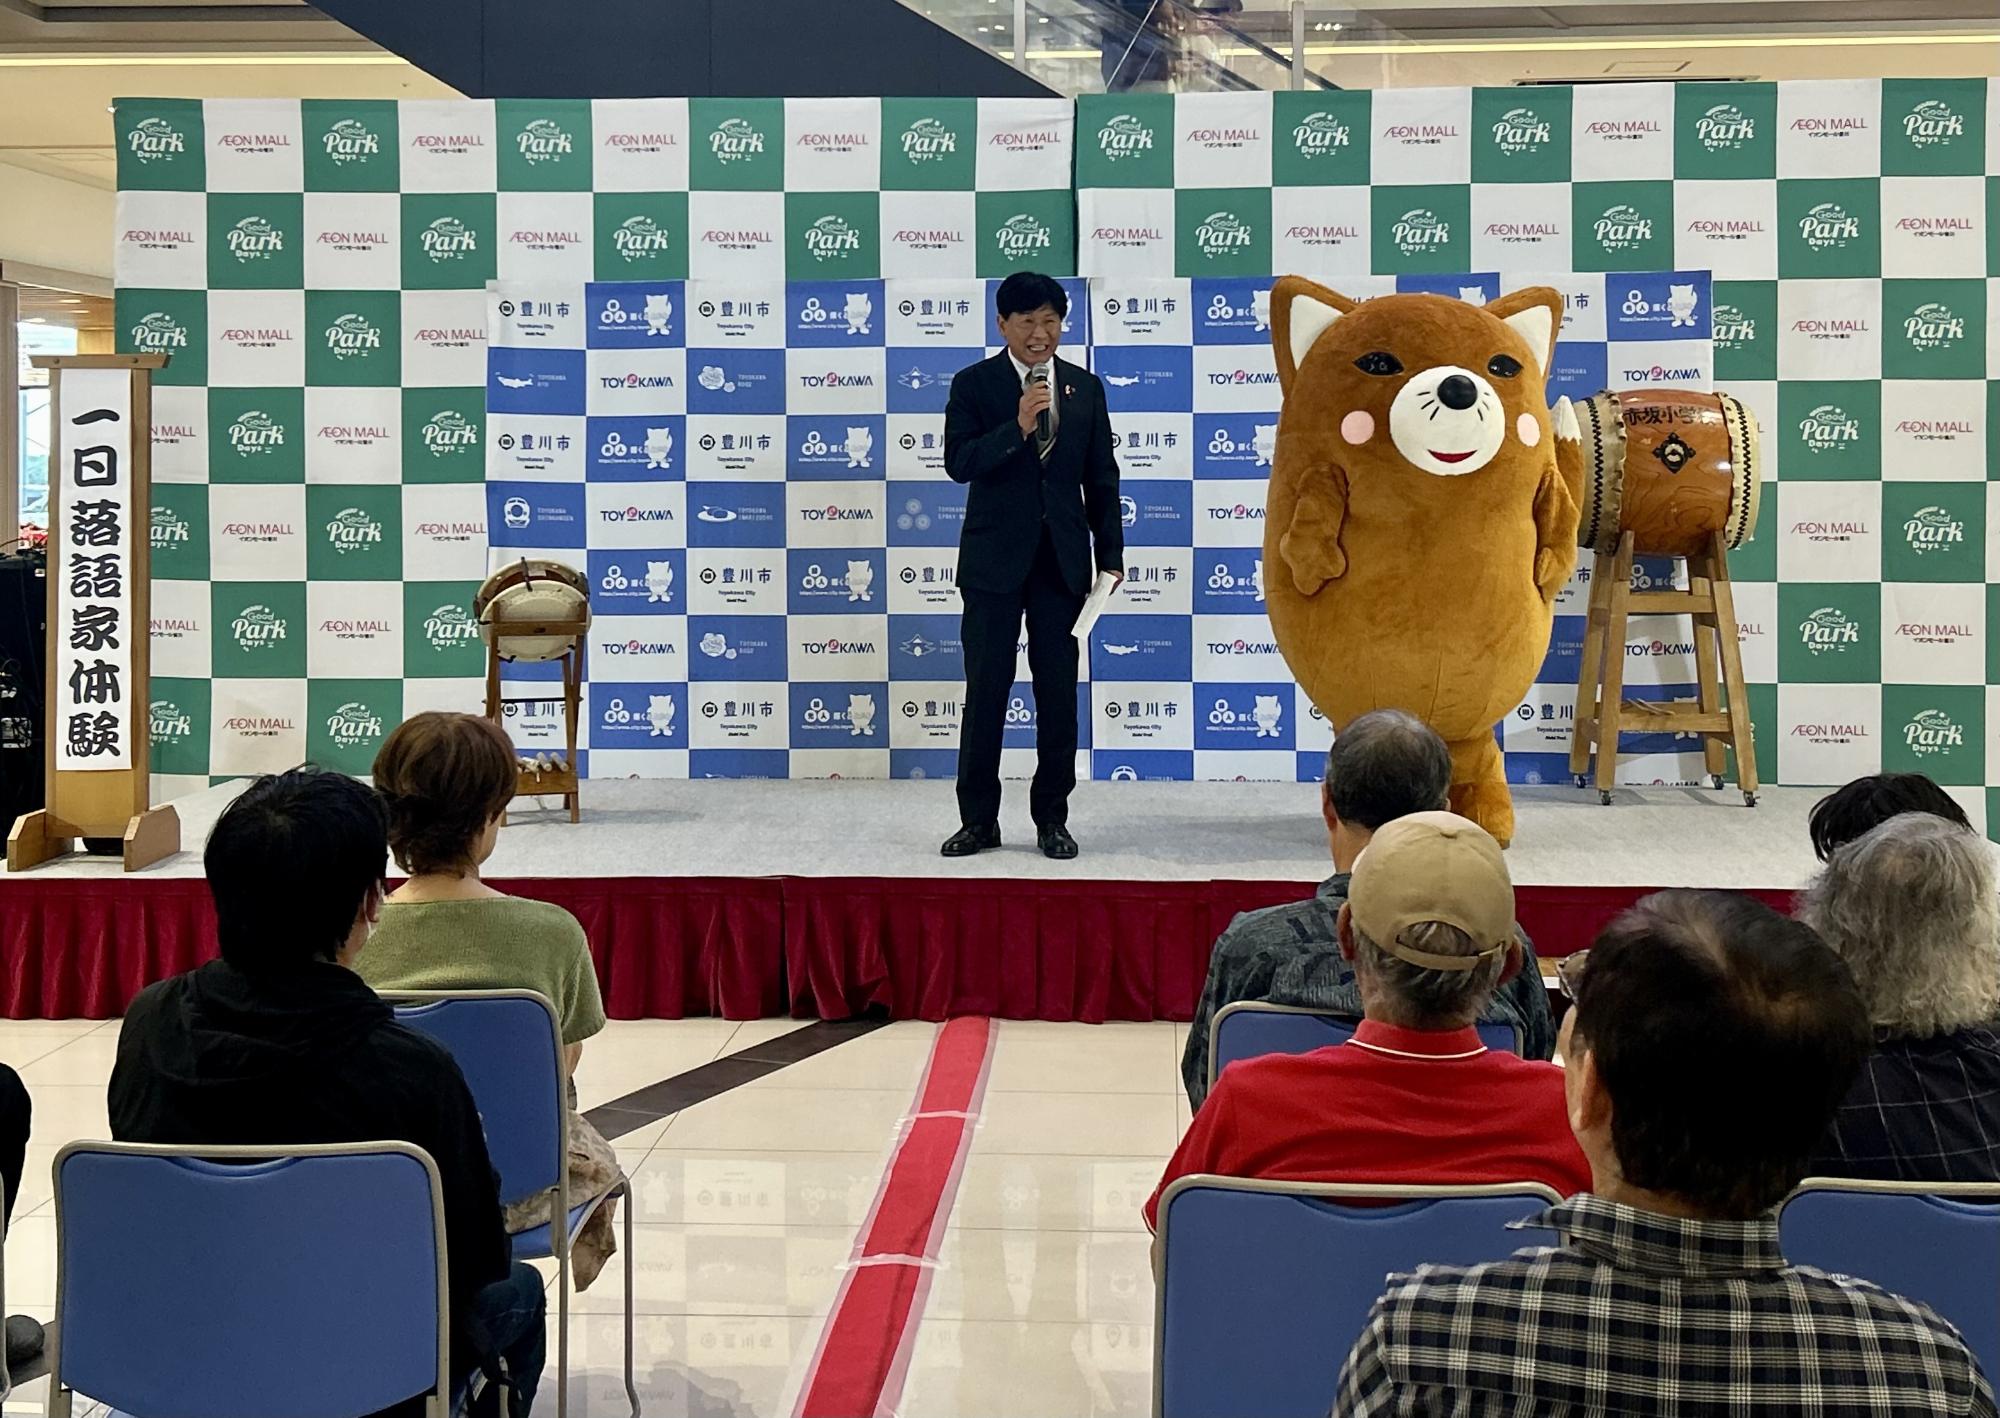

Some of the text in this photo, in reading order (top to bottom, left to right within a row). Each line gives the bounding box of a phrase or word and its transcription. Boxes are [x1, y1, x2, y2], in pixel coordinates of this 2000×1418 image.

[1423, 126, 1458, 136] MALL
[1625, 122, 1660, 132] MALL
[1696, 118, 1754, 140] Park
[1831, 118, 1868, 129] MALL
[1903, 114, 1963, 136] Park
[256, 135, 290, 145] MALL
[643, 134, 677, 145] MALL
[835, 134, 869, 144] MALL
[1027, 133, 1061, 143] MALL
[1098, 128, 1153, 149] Park
[1225, 130, 1260, 140] MALL
[1293, 125, 1349, 146] Park
[1492, 122, 1550, 143] Park
[1913, 136, 1940, 144] Days
[128, 131, 184, 152] Park
[323, 132, 378, 154] Park
[450, 136, 484, 146] MALL
[516, 132, 572, 153] Park
[709, 131, 764, 152] Park
[900, 132, 956, 152] Park
[137, 151, 162, 159] Days
[718, 152, 743, 160] Days
[1106, 148, 1132, 156] Days
[1523, 224, 1559, 234] MALL
[1594, 218, 1652, 240] Park
[1727, 221, 1764, 232] MALL
[1800, 217, 1858, 238] Park
[1936, 218, 1973, 229] MALL
[160, 231, 195, 241] MALL
[354, 232, 388, 243] MALL
[547, 232, 582, 242] MALL
[739, 231, 773, 241] MALL
[805, 228, 859, 250] Park
[930, 231, 964, 241] MALL
[996, 227, 1050, 248] Park
[1128, 228, 1163, 238] MALL
[1195, 225, 1251, 246] Park
[1323, 226, 1358, 237] MALL
[1392, 222, 1449, 244] Park
[227, 230, 283, 251] Park
[420, 230, 476, 251] Park
[614, 229, 668, 250] Park
[1809, 238, 1836, 246] Days
[520, 301, 570, 318] 豊川市
[720, 301, 770, 318] 豊川市
[920, 300, 970, 316] 豊川市
[1126, 298, 1176, 314] 豊川市
[1712, 320, 1755, 340] ark
[1831, 320, 1868, 331] MALL
[1904, 317, 1964, 339] Park
[132, 326, 187, 346] Park
[258, 330, 293, 340] MALL
[326, 327, 380, 348] Park
[452, 329, 486, 339] MALL
[334, 347, 359, 356] Days
[600, 374, 674, 388] TOYOKAWA
[800, 372, 874, 387] TOYOKAWA
[1624, 366, 1701, 382] TOYOKAWA
[1623, 406, 1716, 426] 赤坂小学
[161, 426, 196, 437] MALL
[355, 427, 390, 437] MALL
[1800, 419, 1858, 440] Park
[1936, 421, 1973, 432] MALL
[228, 424, 284, 445] Park
[422, 424, 477, 445] Park
[520, 434, 570, 450] 豊川市
[720, 434, 771, 450] 豊川市
[1126, 432, 1177, 448] 豊川市
[1809, 440, 1836, 448] Days
[600, 506, 674, 521] TOYOKAWA
[800, 506, 874, 520] TOYOKAWA
[1208, 504, 1266, 519] TOYOKA
[151, 520, 189, 541] ark
[260, 524, 294, 534] MALL
[326, 521, 381, 542] Park
[453, 524, 487, 534] MALL
[1831, 522, 1868, 533] MALL
[1904, 520, 1963, 542] Park
[1913, 541, 1940, 550] Days
[720, 568, 771, 584] 豊川市
[923, 566, 953, 582] 豊川
[1126, 566, 1177, 582] 豊川市
[66, 409, 121, 758] 一日落語家体験
[165, 620, 200, 631] MALL
[232, 618, 286, 639] Park
[357, 621, 392, 631] MALL
[424, 618, 478, 639] Park
[1799, 621, 1858, 643] Park
[1935, 624, 1972, 635] MALL
[240, 639, 265, 647] Days
[602, 640, 676, 654] TOYOKAWA
[801, 640, 874, 654] TOYOKAWA
[1809, 642, 1835, 651] Days
[722, 701, 773, 718] 豊川市
[1126, 702, 1177, 718] 豊川市
[1541, 703, 1573, 720] 豊川
[260, 718, 295, 728] MALL
[327, 716, 381, 736] Park
[1831, 725, 1868, 735] MALL
[1903, 723, 1963, 745] Park
